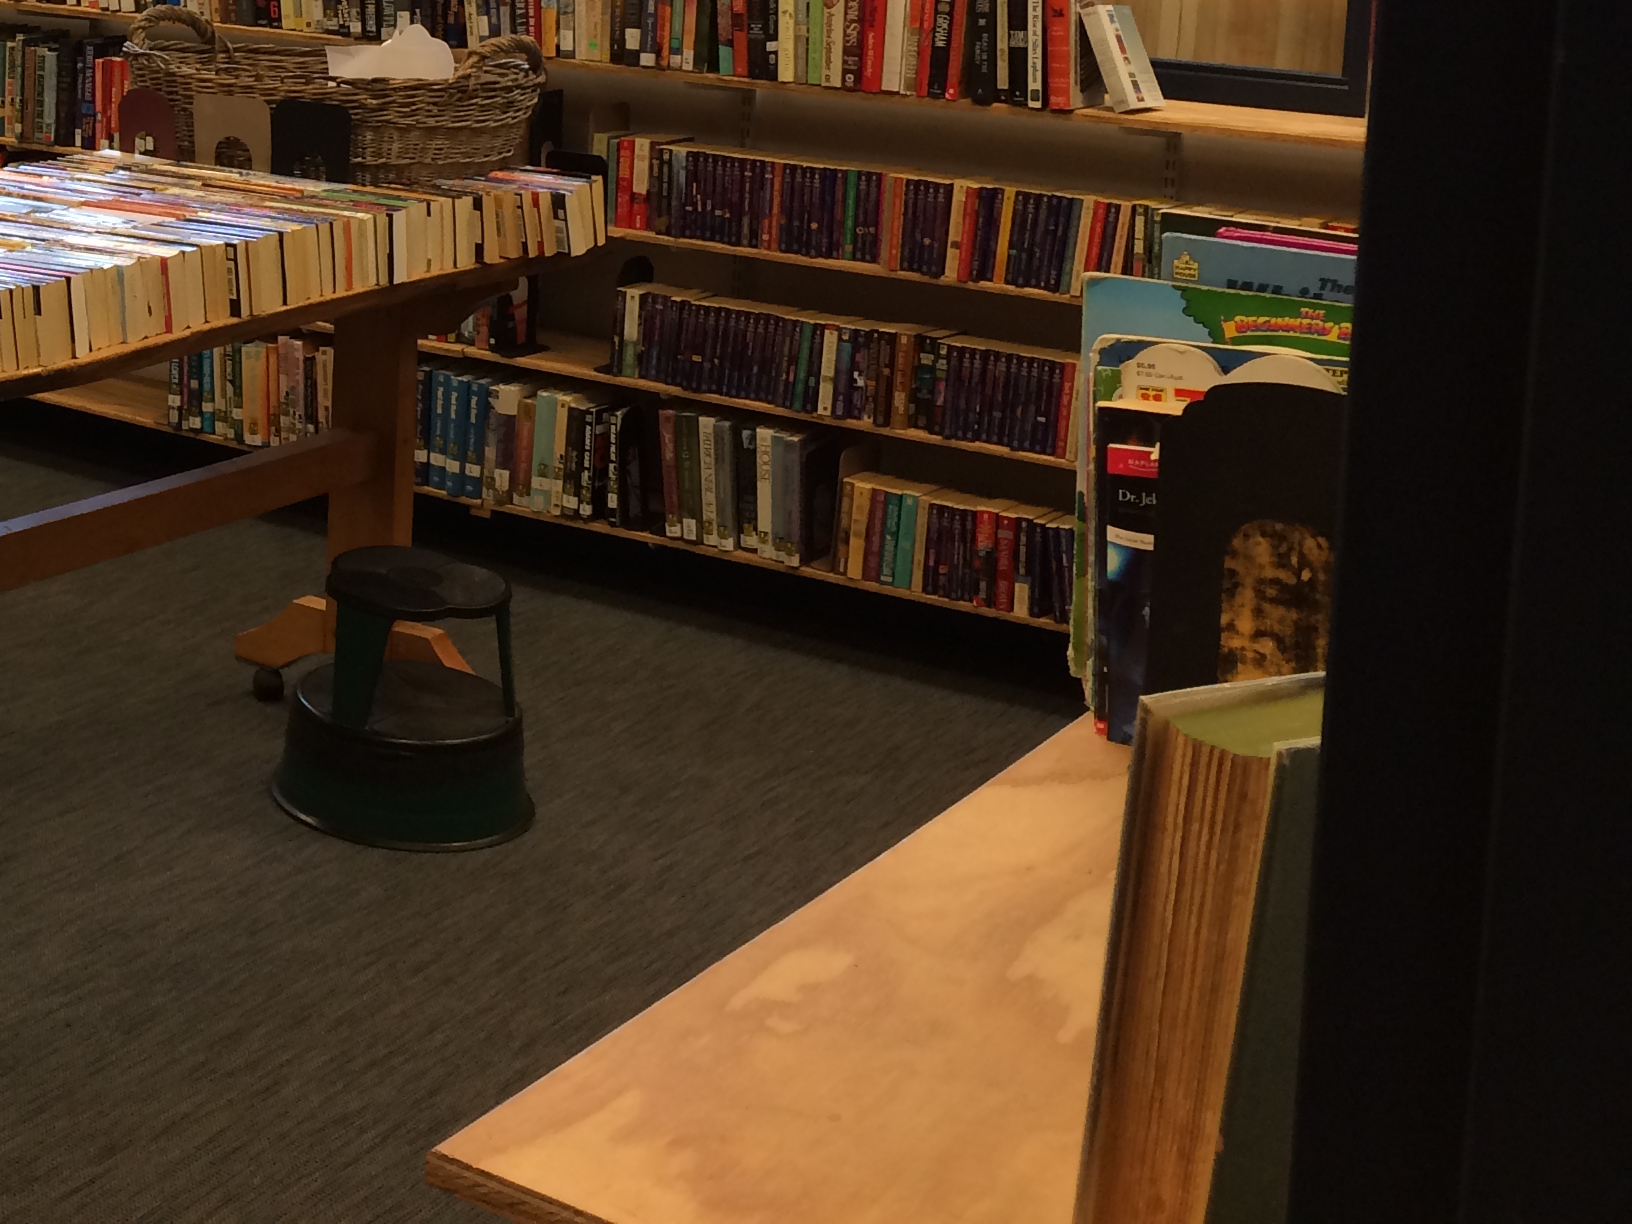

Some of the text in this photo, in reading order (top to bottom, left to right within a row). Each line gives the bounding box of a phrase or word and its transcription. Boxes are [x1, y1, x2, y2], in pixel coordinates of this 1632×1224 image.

[1031, 0, 1040, 12] The
[933, 14, 951, 48] GRISHAM
[1031, 14, 1039, 28] Rise
[844, 22, 860, 47] SINS
[1029, 56, 1039, 84] Lapham
[1299, 308, 1326, 321] THE
[759, 444, 771, 482] HOUSE
[1118, 488, 1140, 503] Dr.
